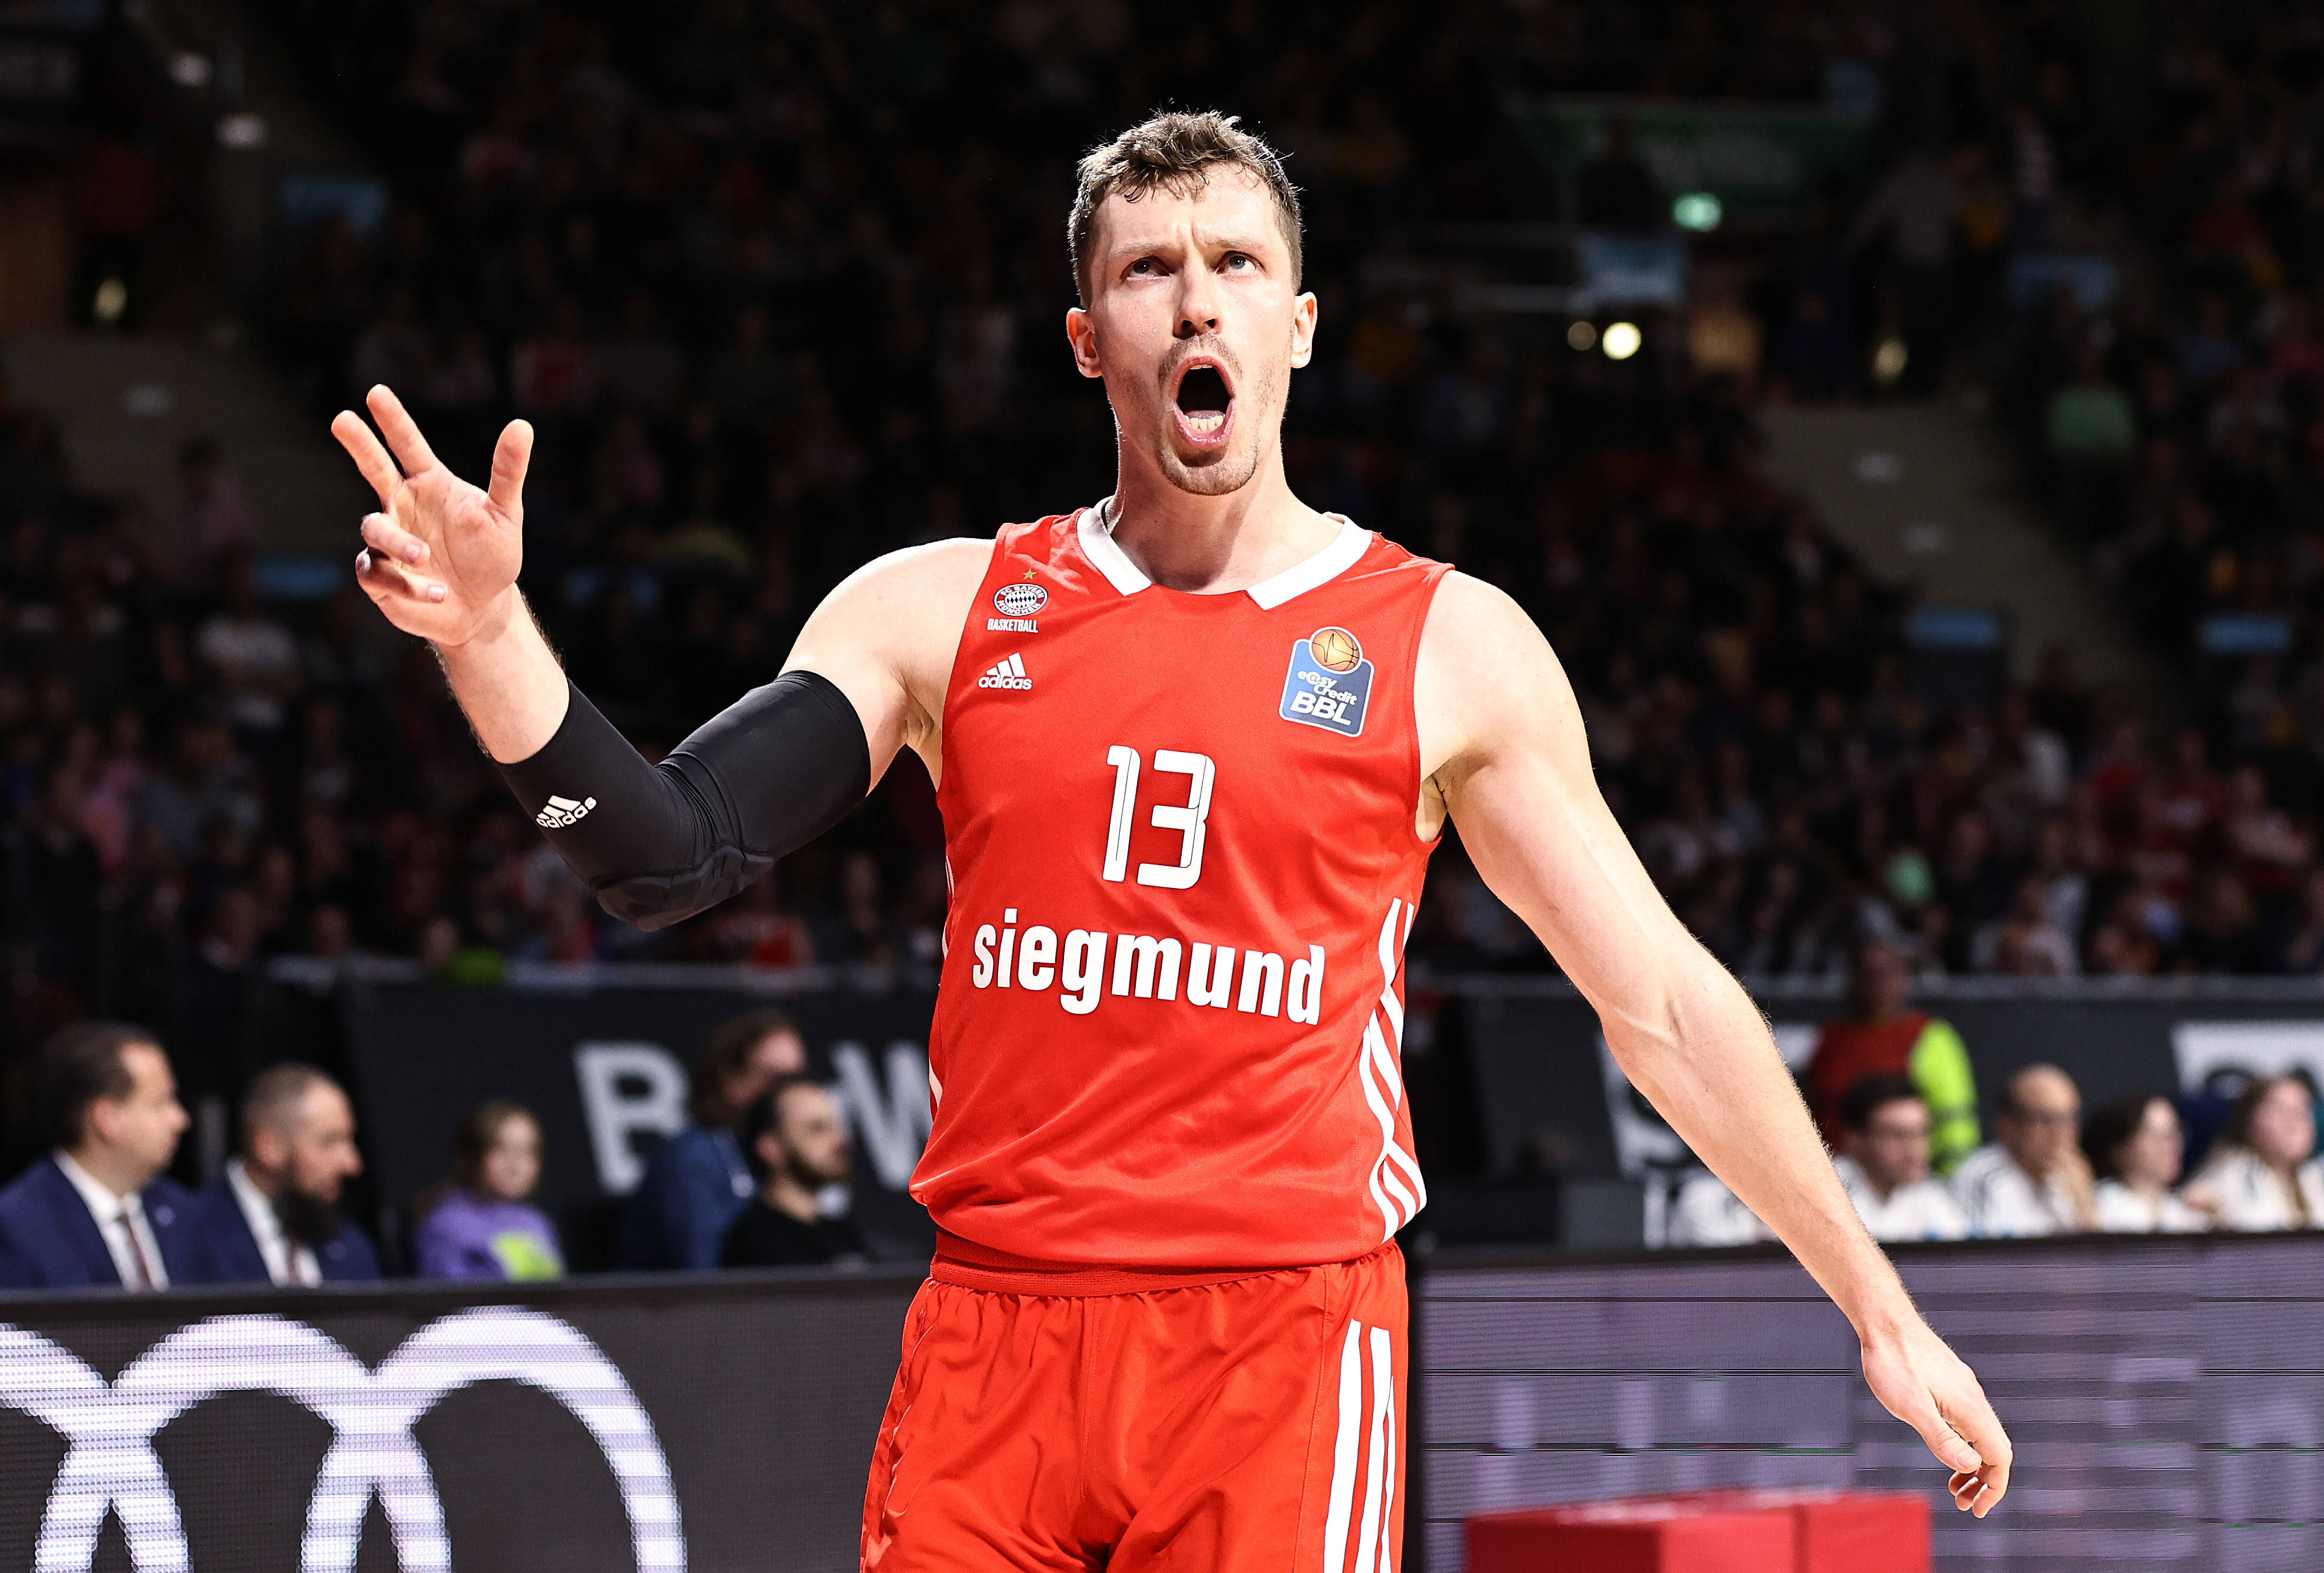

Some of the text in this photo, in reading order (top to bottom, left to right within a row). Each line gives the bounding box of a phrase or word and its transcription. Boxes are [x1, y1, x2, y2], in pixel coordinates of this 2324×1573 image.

[1000, 585, 1045, 599] FC BAYERN
[987, 618, 1039, 633] BASKETBALL
[978, 674, 1032, 690] adidas
[1290, 690, 1352, 726] BBL
[1102, 745, 1216, 890] 13
[972, 908, 1325, 1026] siegmund
